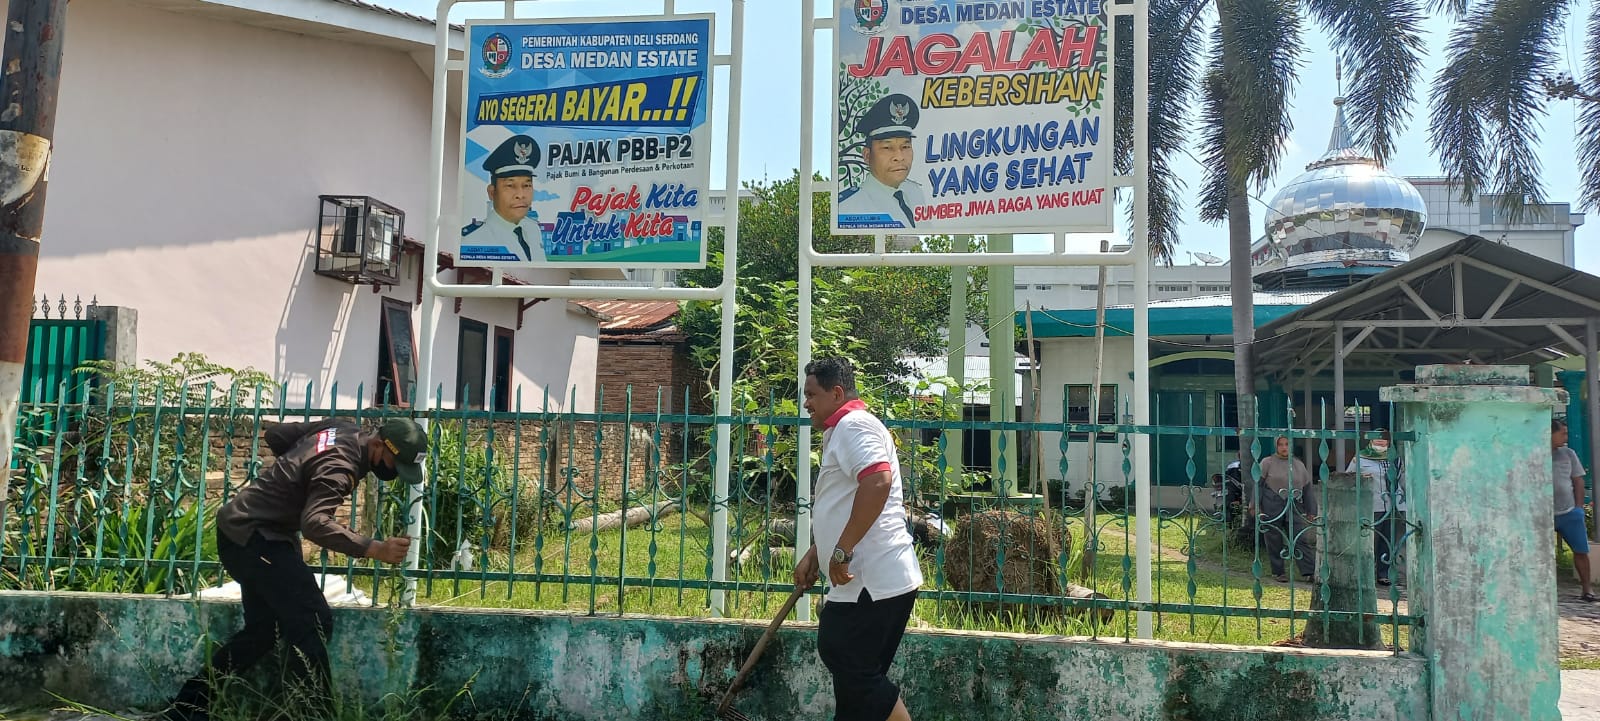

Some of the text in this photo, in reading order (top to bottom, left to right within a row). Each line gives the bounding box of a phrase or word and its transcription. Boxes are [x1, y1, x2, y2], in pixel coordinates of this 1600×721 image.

[901, 0, 1100, 25] DESA MEDAN ESTATE
[522, 33, 698, 48] PEMERINTAH KABUPATEN DELI SERDANG
[848, 26, 1100, 78] JAGALAH
[521, 50, 698, 69] DESA MEDAN ESTATE
[920, 70, 1100, 109] KEBERSIHAN
[478, 100, 498, 121] AYO
[500, 92, 559, 121] SEGERA
[547, 134, 693, 167] PAJAK PBB-P2
[925, 116, 1100, 163] LINGKUNGAN
[546, 162, 694, 180] Pajak Bumi & Bangunan Perdesaan & Perkotaan
[929, 152, 1093, 197] YANG SEHAT
[570, 183, 698, 216] Pajak Kita
[914, 188, 1104, 222] SUMBER JIWA RAGA YANG KUAT
[552, 213, 673, 244] Untuk Kita
